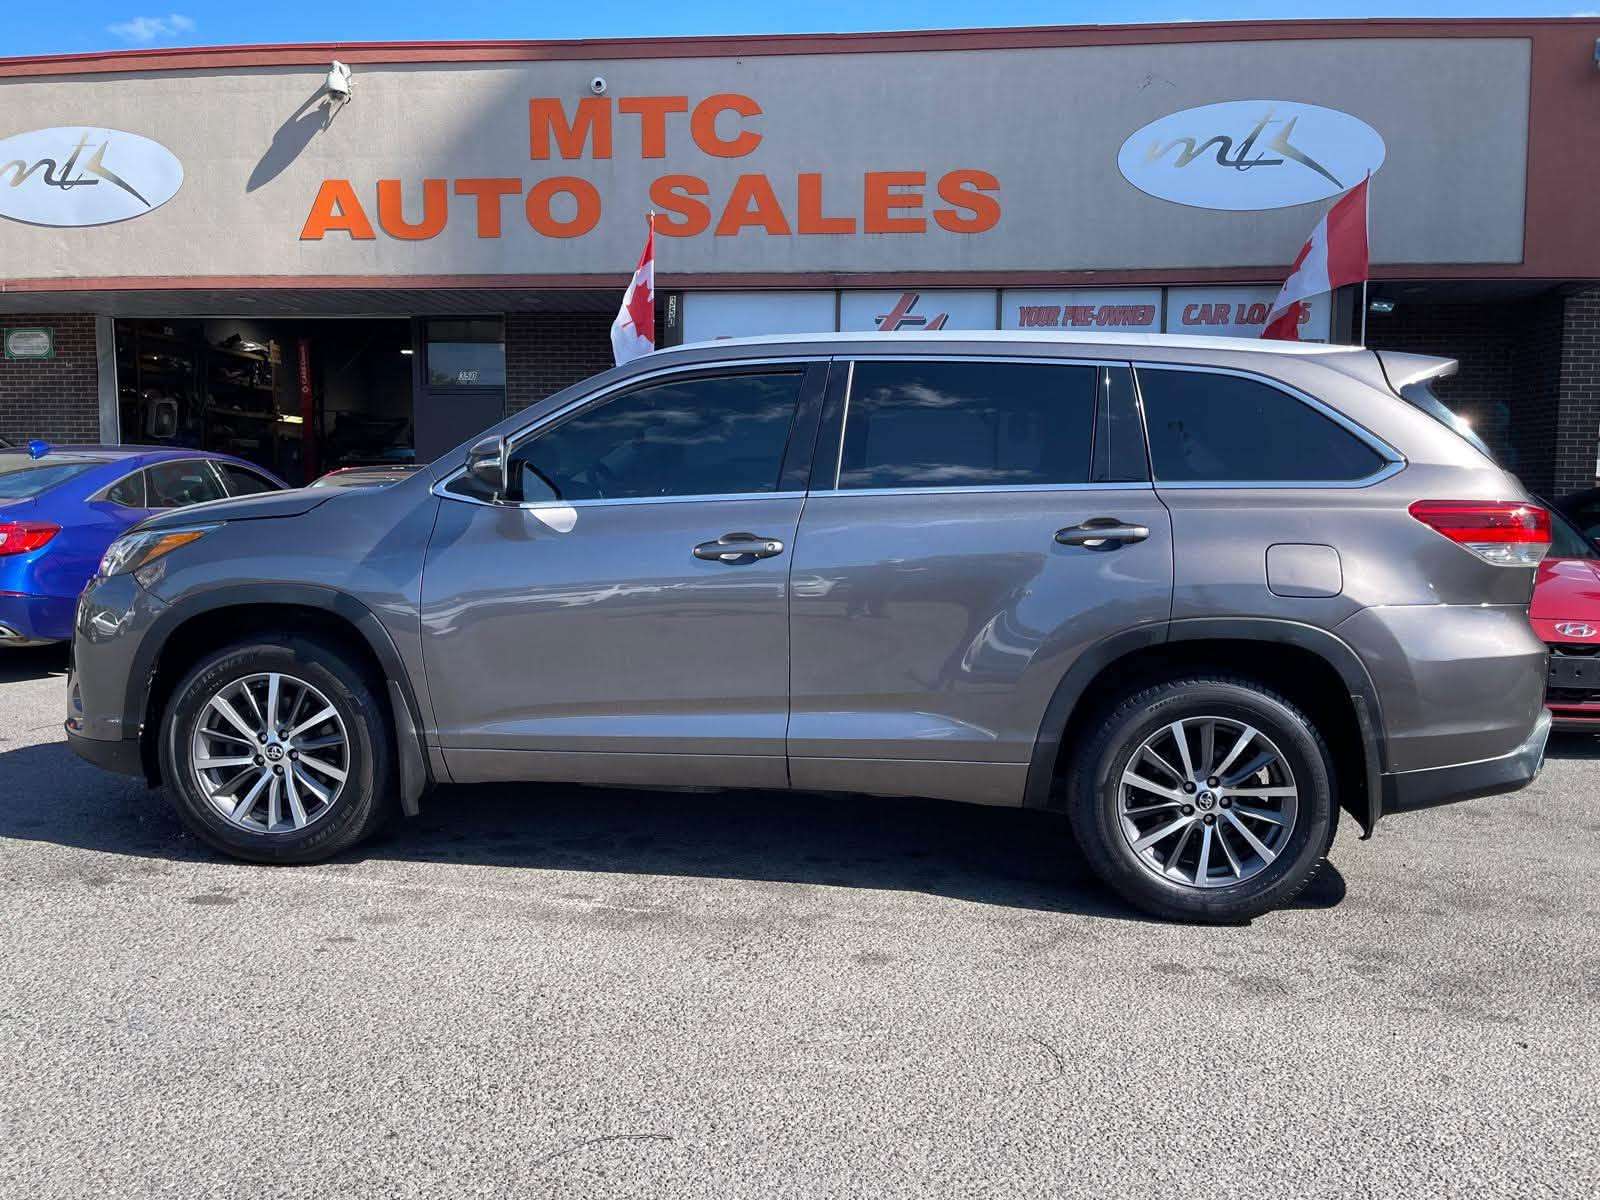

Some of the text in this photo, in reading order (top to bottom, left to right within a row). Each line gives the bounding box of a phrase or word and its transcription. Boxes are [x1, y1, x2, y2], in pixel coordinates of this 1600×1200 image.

[529, 93, 763, 160] MTC
[299, 168, 1002, 241] AUTO SALES
[1019, 304, 1156, 327] YOUR PRE-OWNED
[1182, 302, 1312, 326] CAR LOS
